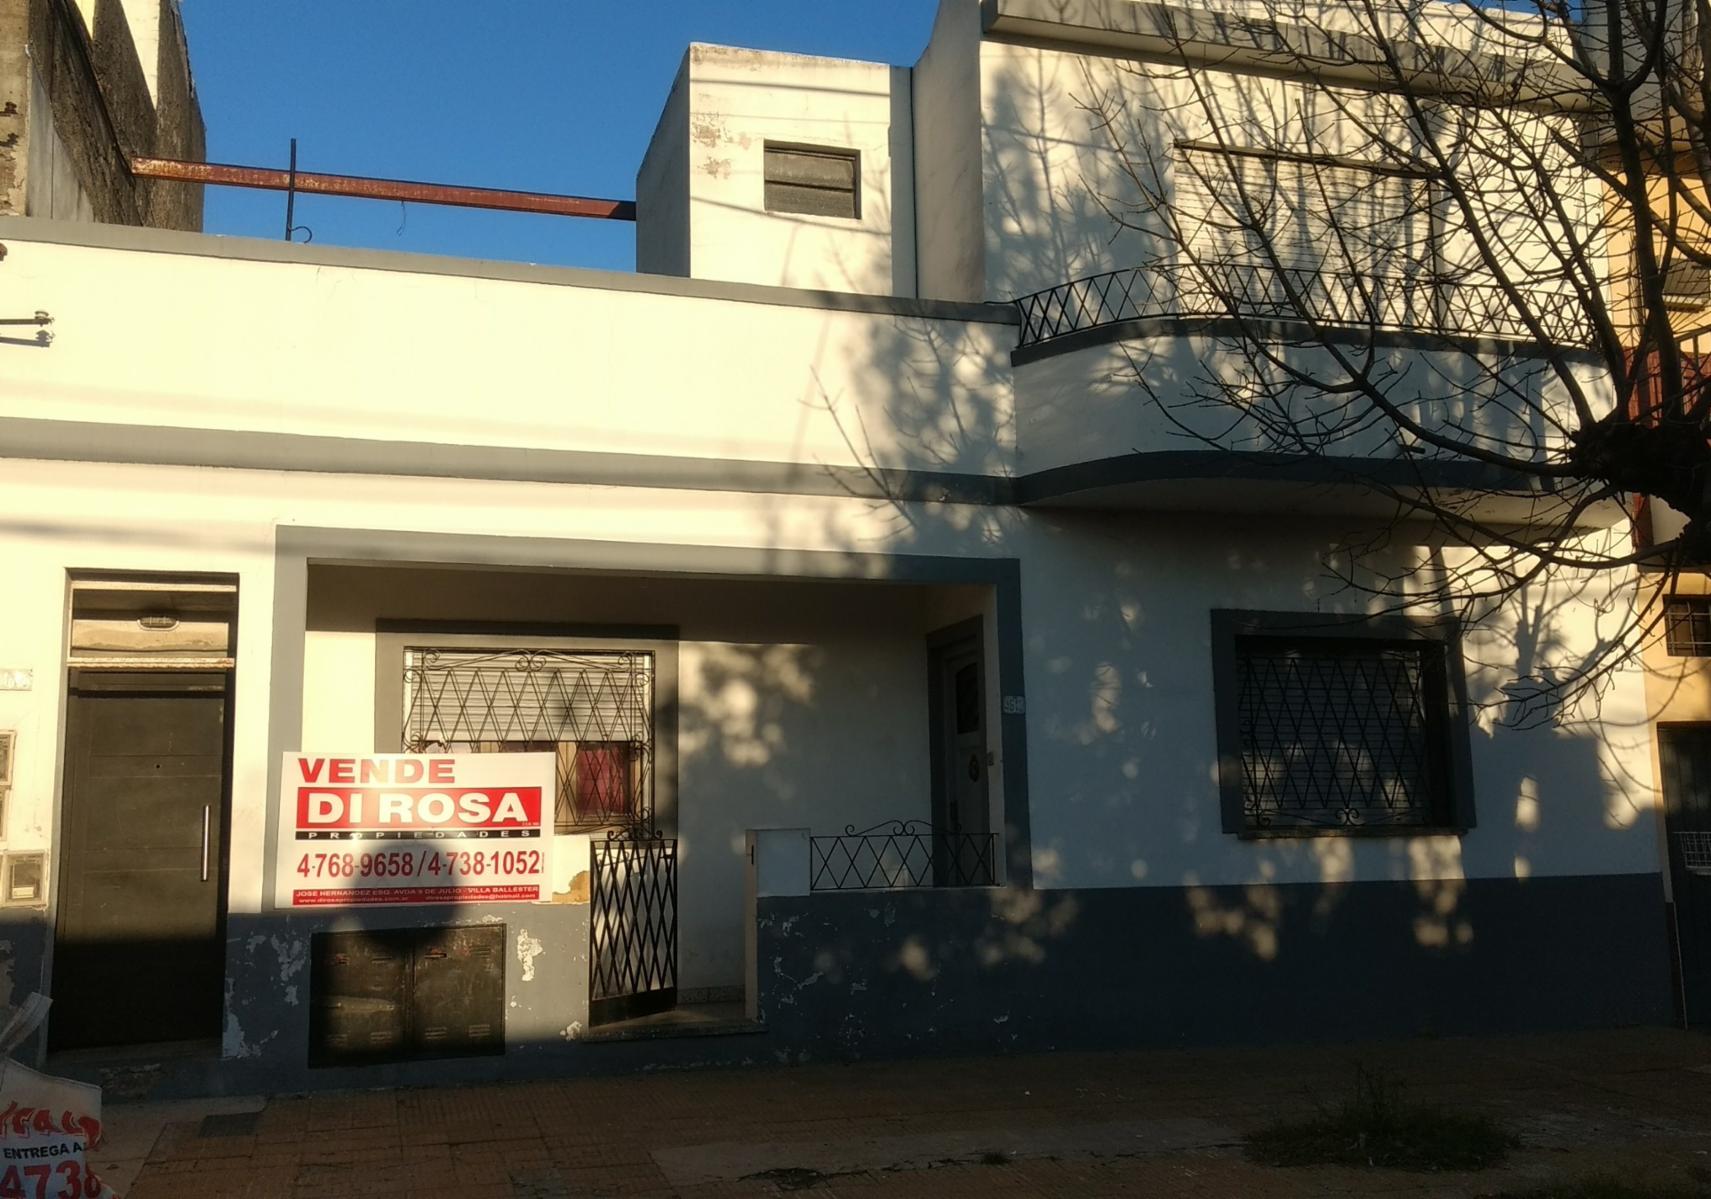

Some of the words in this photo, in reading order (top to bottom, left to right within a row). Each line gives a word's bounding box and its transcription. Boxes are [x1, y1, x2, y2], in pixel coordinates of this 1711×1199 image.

[298, 758, 455, 784] VENDE
[307, 792, 363, 824] DI
[378, 792, 529, 824] ROSA
[308, 830, 530, 839] PROPIEDADES
[297, 852, 414, 878] 4-768-9658
[427, 850, 540, 876] 4-738-1052
[320, 889, 371, 897] HERNANDEZ
[3, 1143, 70, 1159] ENTREGA
